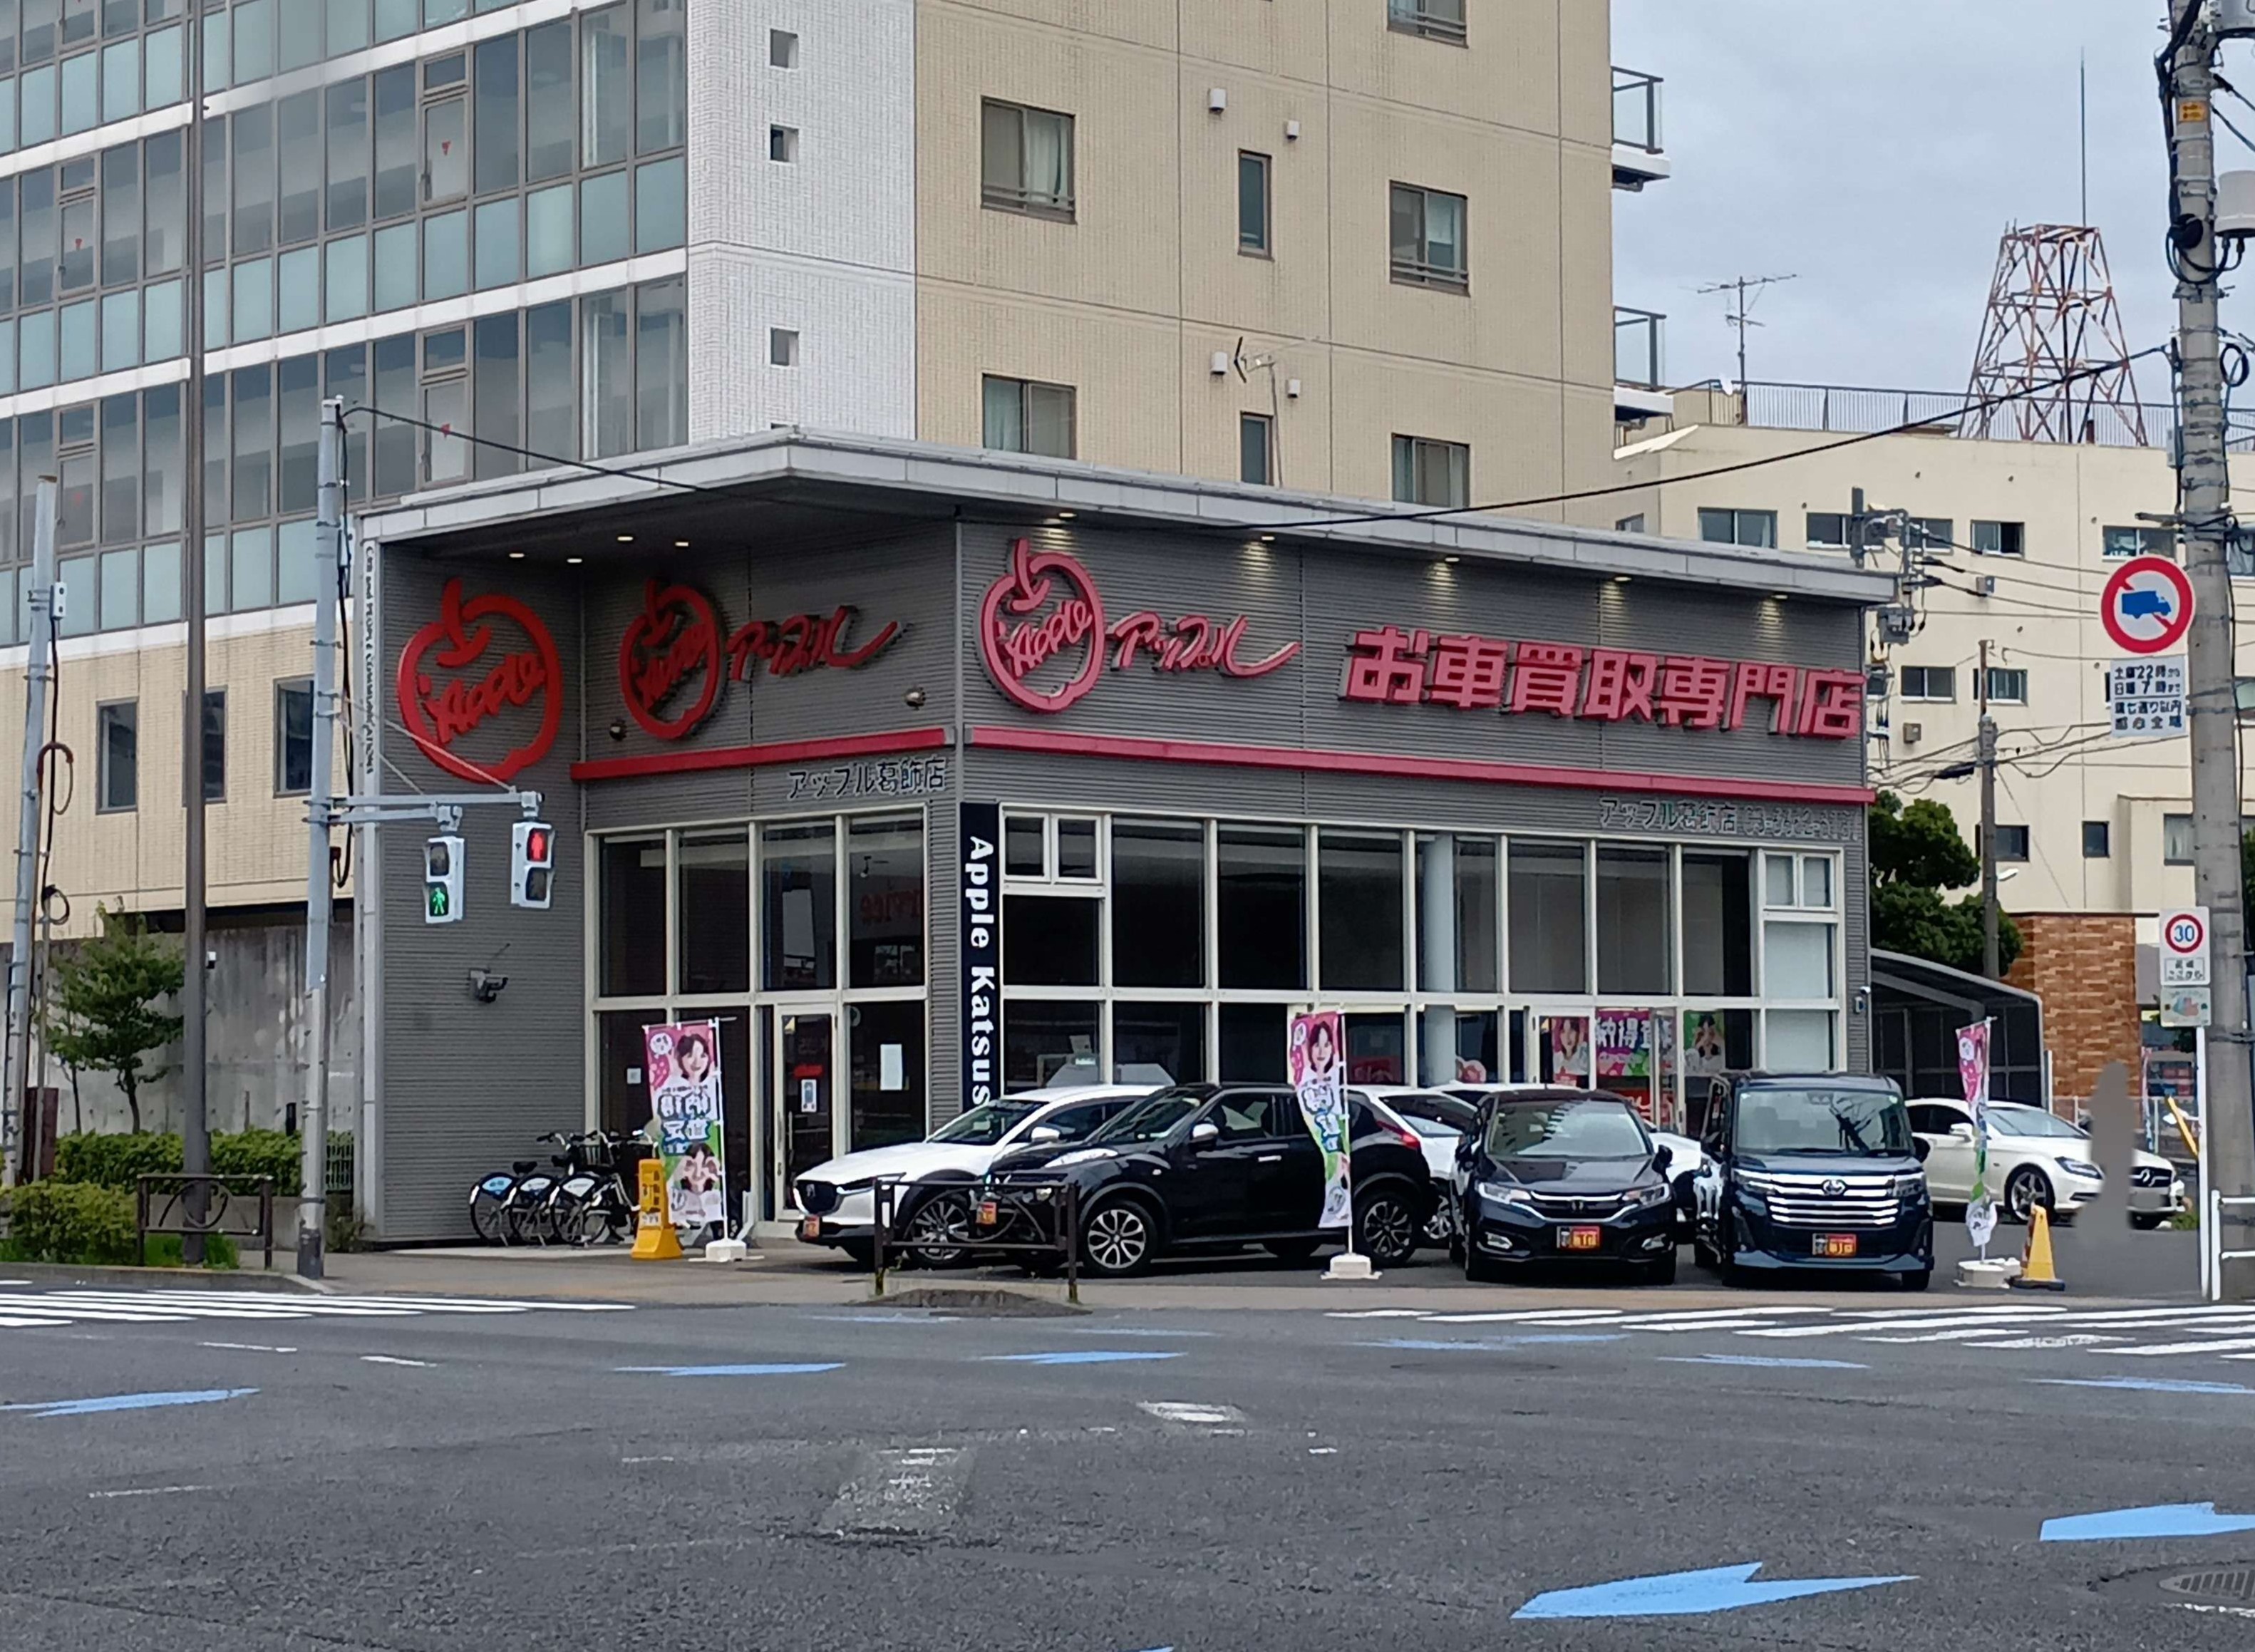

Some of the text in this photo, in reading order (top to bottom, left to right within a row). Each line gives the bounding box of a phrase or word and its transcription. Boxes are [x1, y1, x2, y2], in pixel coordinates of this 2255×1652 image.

[1114, 610, 1302, 679] アップル
[1346, 625, 1866, 741] お車買取専門店
[788, 756, 947, 799] アップル葛飾店
[964, 835, 995, 949] Apple
[2173, 924, 2196, 943] 30
